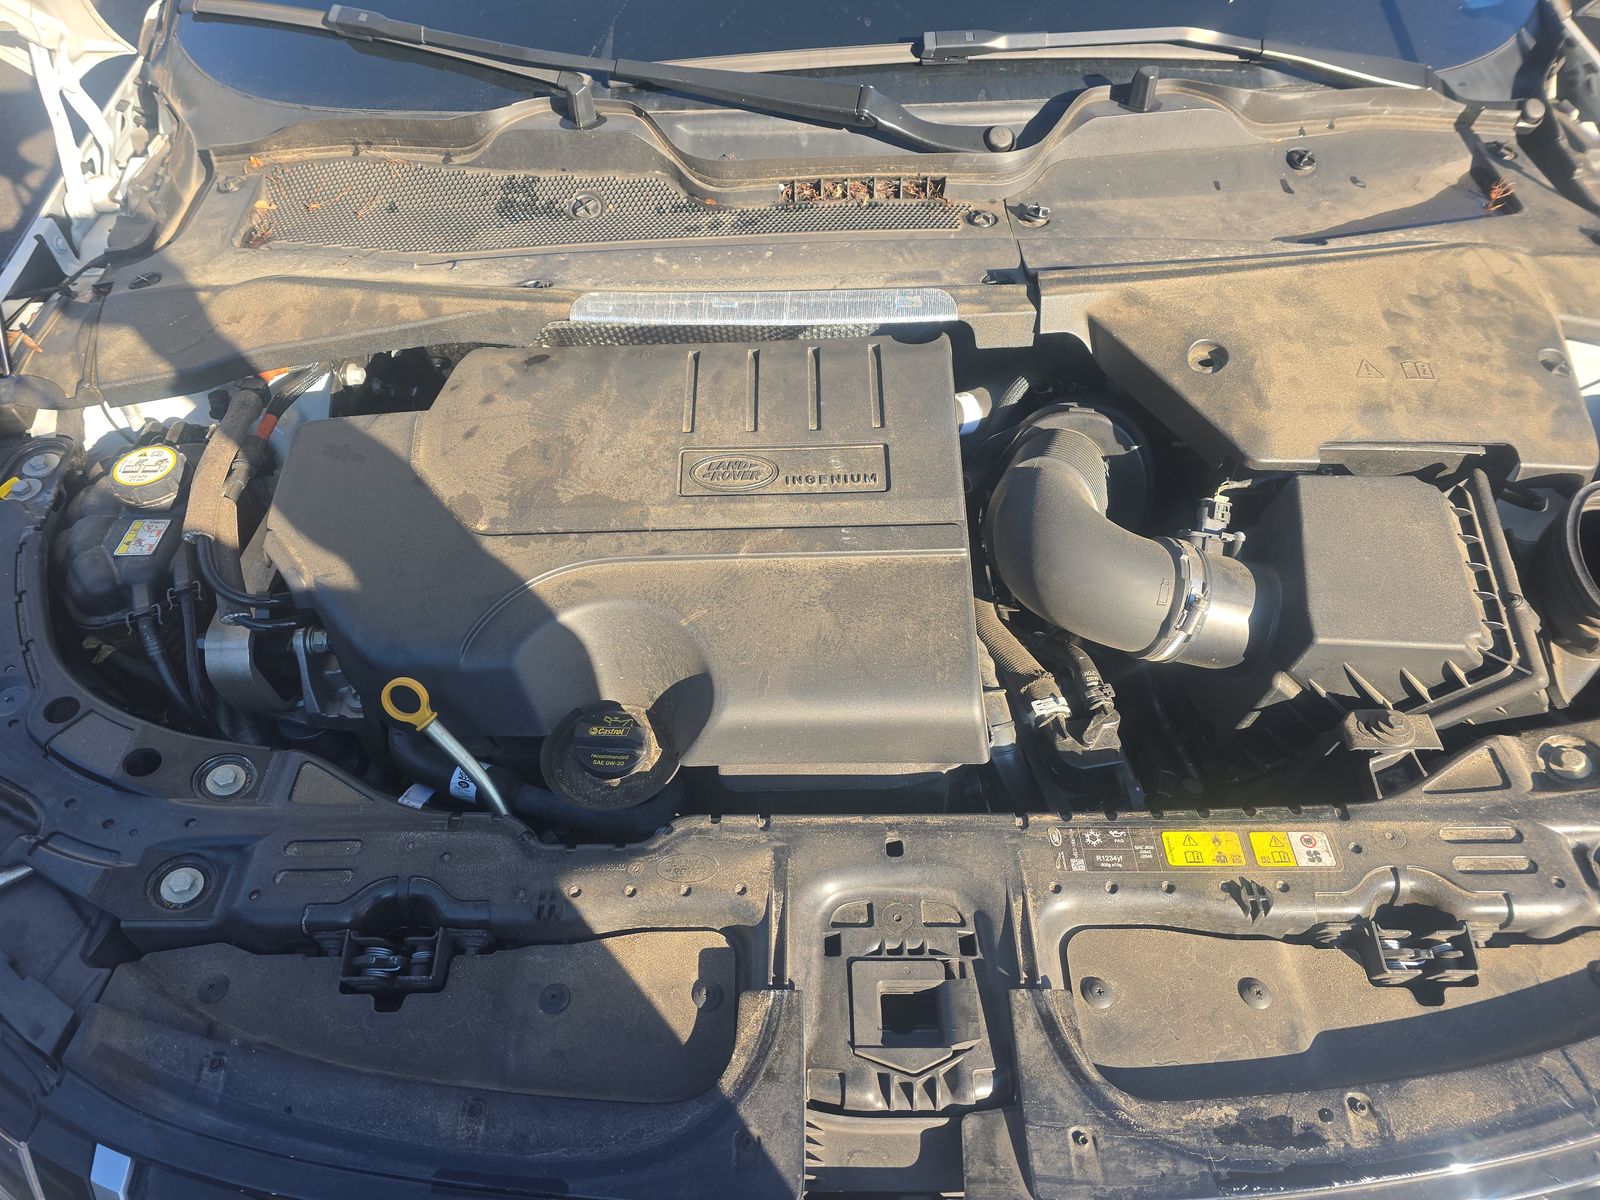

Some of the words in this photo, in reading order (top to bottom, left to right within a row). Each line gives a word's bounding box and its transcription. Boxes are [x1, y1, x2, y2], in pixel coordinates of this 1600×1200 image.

[708, 460, 748, 471] LAND
[710, 470, 761, 482] ROVER
[785, 472, 878, 486] INGENIUM
[597, 727, 625, 736] Castrol
[1096, 855, 1123, 863] R1234yf
